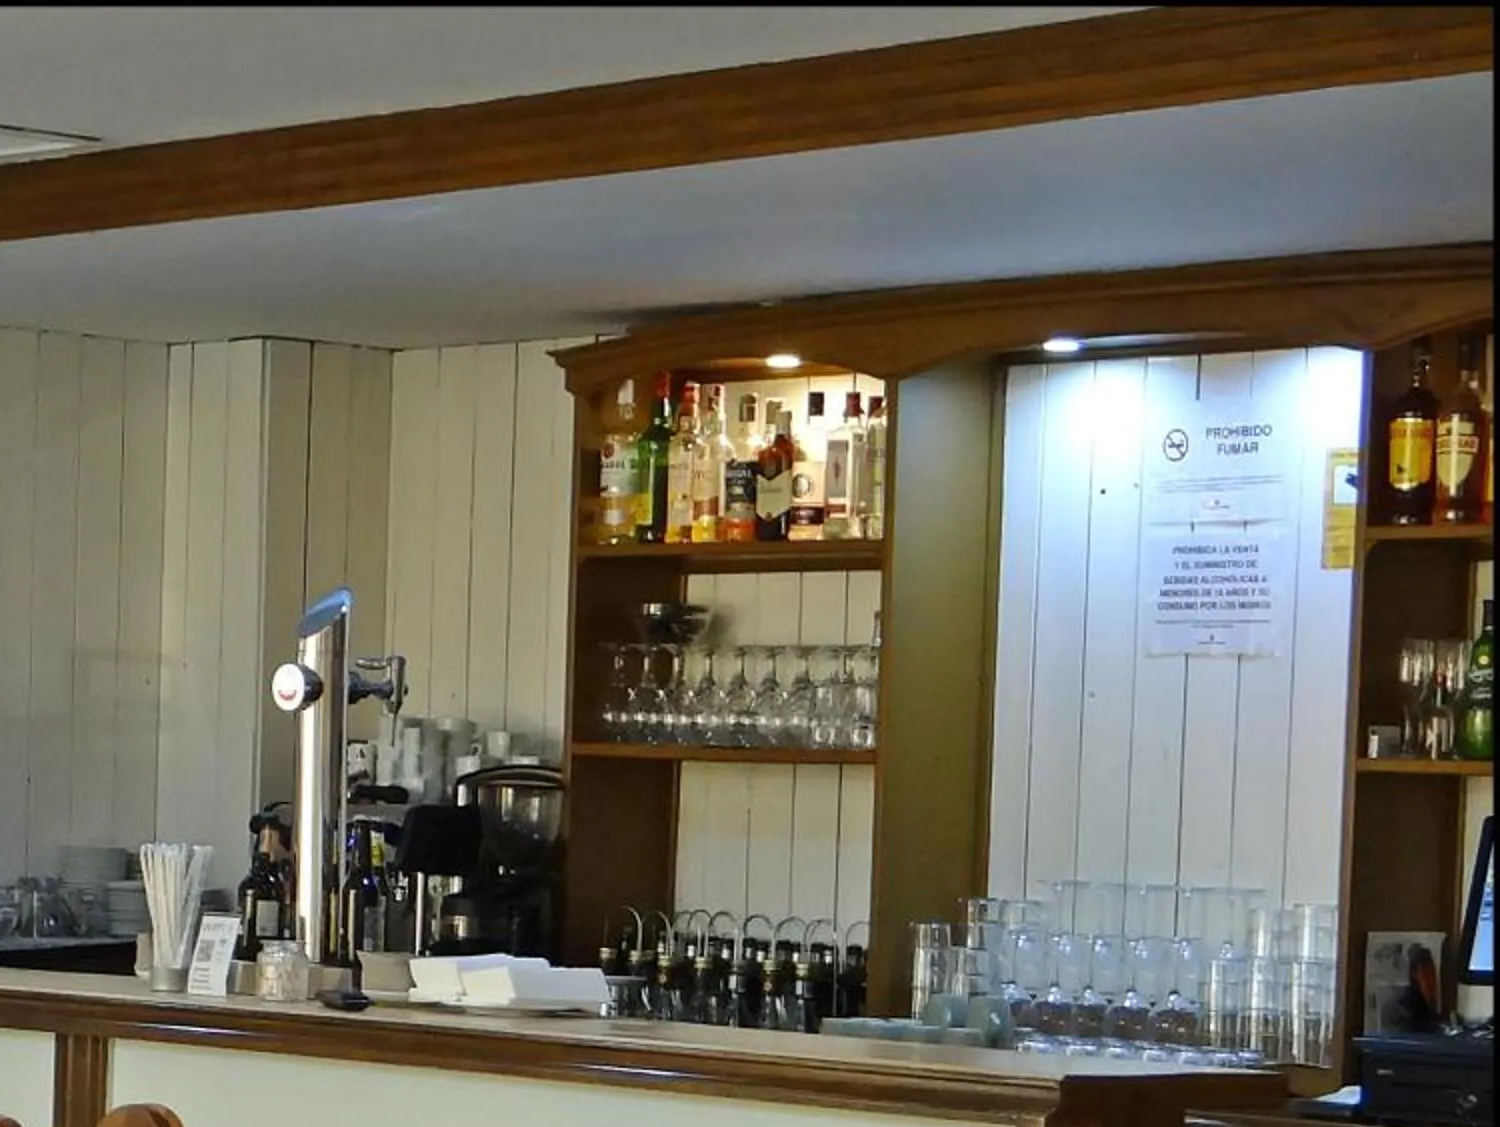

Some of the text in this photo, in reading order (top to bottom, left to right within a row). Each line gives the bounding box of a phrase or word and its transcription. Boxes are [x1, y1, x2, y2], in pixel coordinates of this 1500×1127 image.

[1205, 424, 1273, 440] PROHIBIDO
[1217, 441, 1259, 455] FUMAR
[1219, 545, 1230, 554] LA
[1232, 544, 1259, 554] VENTA
[1181, 561, 1191, 569] EL
[1246, 559, 1258, 568] DE
[1201, 588, 1213, 597] DE
[1200, 601, 1218, 611] POR
[1219, 602, 1237, 610] LOS
